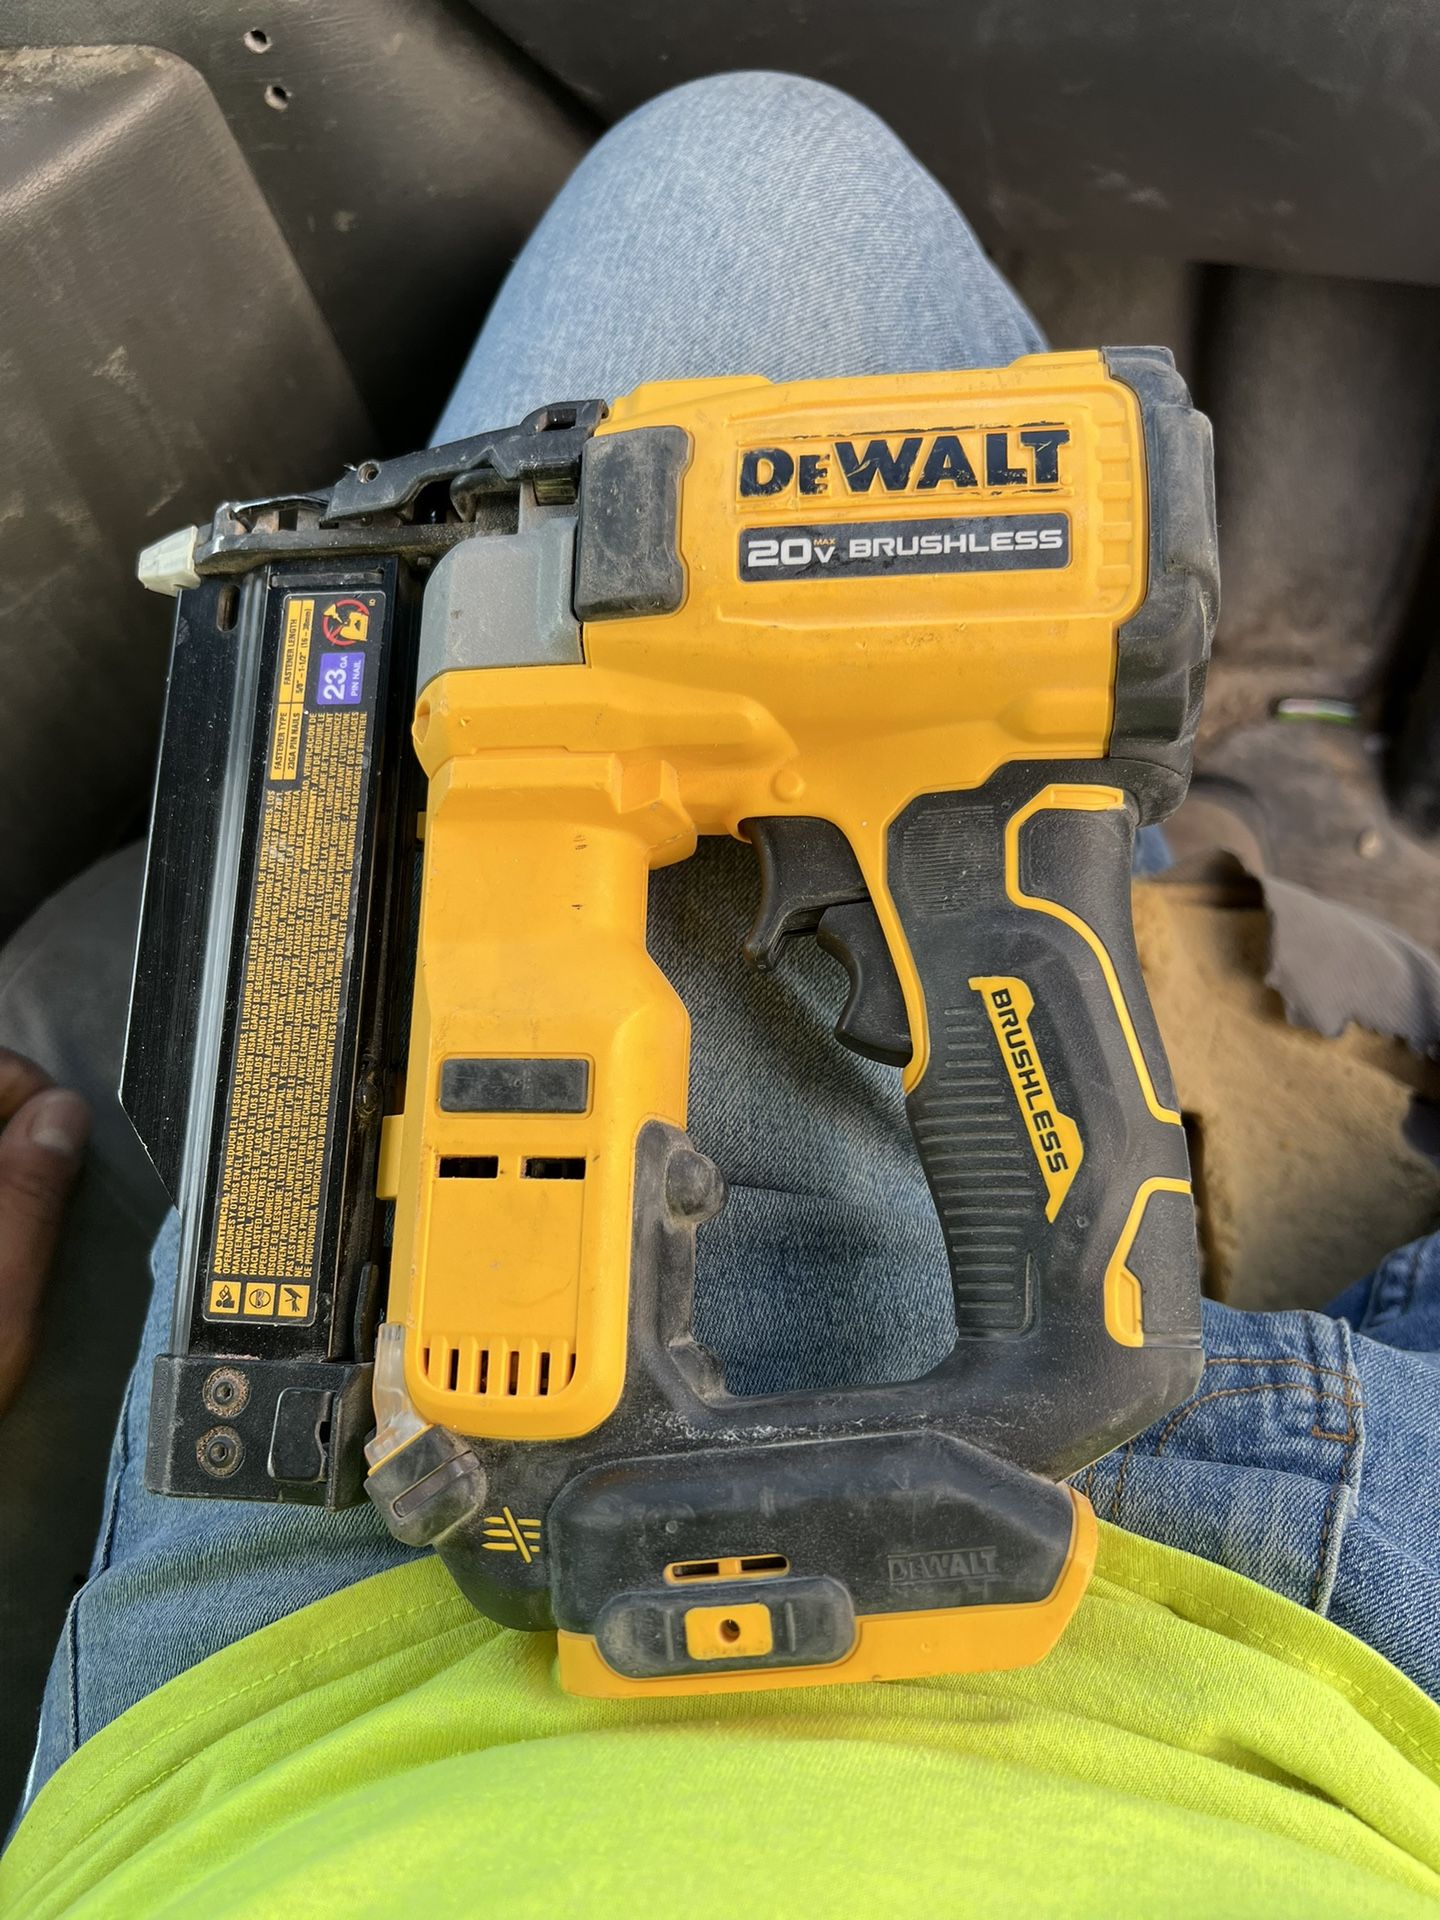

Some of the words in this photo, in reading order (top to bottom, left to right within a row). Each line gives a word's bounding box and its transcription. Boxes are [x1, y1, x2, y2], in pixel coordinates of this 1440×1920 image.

[849, 529, 1063, 559] BRUSHLESS
[287, 619, 298, 647] LENGTH
[283, 648, 295, 685] FASTENER
[322, 668, 348, 700] 23
[341, 655, 348, 668] GA
[352, 660, 362, 679] NAIL
[350, 681, 359, 696] PIN
[278, 713, 288, 731] TYPE
[291, 712, 301, 735] NAILS
[322, 713, 334, 759] TRAVAILLENT
[274, 733, 286, 770] FASTENER
[289, 736, 298, 750] PIN
[287, 752, 296, 770] 23GA
[336, 764, 346, 787] AVANT
[325, 778, 336, 810] LORSQUE
[342, 766, 354, 815] AJUSTEMENT
[281, 790, 292, 832] DESCARGA
[288, 790, 301, 845] HERRAMIENTA
[302, 786, 318, 870] AVERTISSEMENT:
[330, 789, 343, 844] CORRECTEMENT
[268, 831, 279, 872] LATERALES
[311, 819, 323, 864] PERSONNES
[338, 821, 348, 854] LORSQUE
[275, 852, 285, 880] EVITAR
[283, 858, 293, 888] APUNTE
[308, 865, 318, 894] AUTRES
[326, 846, 337, 892] FONCTIONNE
[254, 883, 265, 917] MANUAL
[262, 874, 275, 926] PROTECTORES
[280, 890, 290, 918] NUNCA
[332, 884, 342, 914] RETIREZ
[313, 908, 322, 935] DOIGTS
[284, 926, 295, 956] AJUSTE
[300, 922, 312, 975] UTILISATEURS
[321, 1043, 335, 1115] FONCTIONNEMENT
[334, 933, 346, 977] PRINCIPALE
[352, 766, 362, 803] BLOCAGES
[255, 946, 267, 990] SEGURIDAD
[273, 956, 283, 982] ANTES
[280, 957, 291, 994] CUANDO:
[308, 953, 318, 982] GARDEZ
[243, 983, 254, 1018] USUARIO
[250, 1004, 260, 1030] GAFAS
[257, 1019, 267, 1054] CUANDO
[265, 984, 280, 1056] ADECUADAMENTE
[317, 1012, 329, 1060] PERSONNES
[245, 1055, 255, 1082] DEBEN
[252, 1056, 263, 1095] GATILLOS
[261, 1058, 272, 1089] OPEREN
[272, 1045, 282, 1072] RETIRE
[289, 1052, 299, 1076] GUIDE
[990, 987, 1070, 1174] BRUSHLESS
[232, 1087, 243, 1117] RIESGO
[241, 1084, 252, 1120] TRABAJO
[257, 1092, 268, 1130] GATILLOS
[275, 1088, 286, 1131] PRINCIPAL
[227, 1130, 238, 1166] REDUCIR
[243, 1129, 255, 1172] ALEJADOS
[271, 1133, 282, 1166] GATILLO
[286, 1151, 297, 1190] LUNETTES
[230, 1183, 241, 1209] OTROS
[240, 1175, 250, 1203] DEDOS
[257, 1180, 268, 1208] OTROS
[264, 1181, 276, 1224] CORRECTA
[281, 1209, 291, 1239] PORTER
[289, 1201, 301, 1243] FIXATIONS
[300, 1193, 311, 1229] POINTER
[214, 1192, 230, 1273] ADVERTENCIA:
[223, 1219, 236, 1274] OPERADORES
[232, 1224, 245, 1274] MANTENGA
[253, 1218, 263, 1246] USTED
[296, 1231, 307, 1263] JAMAIS
[250, 1248, 260, 1275] HACIA
[268, 1246, 278, 1276] RISQUE
[277, 1242, 288, 1276] DOIVENT
